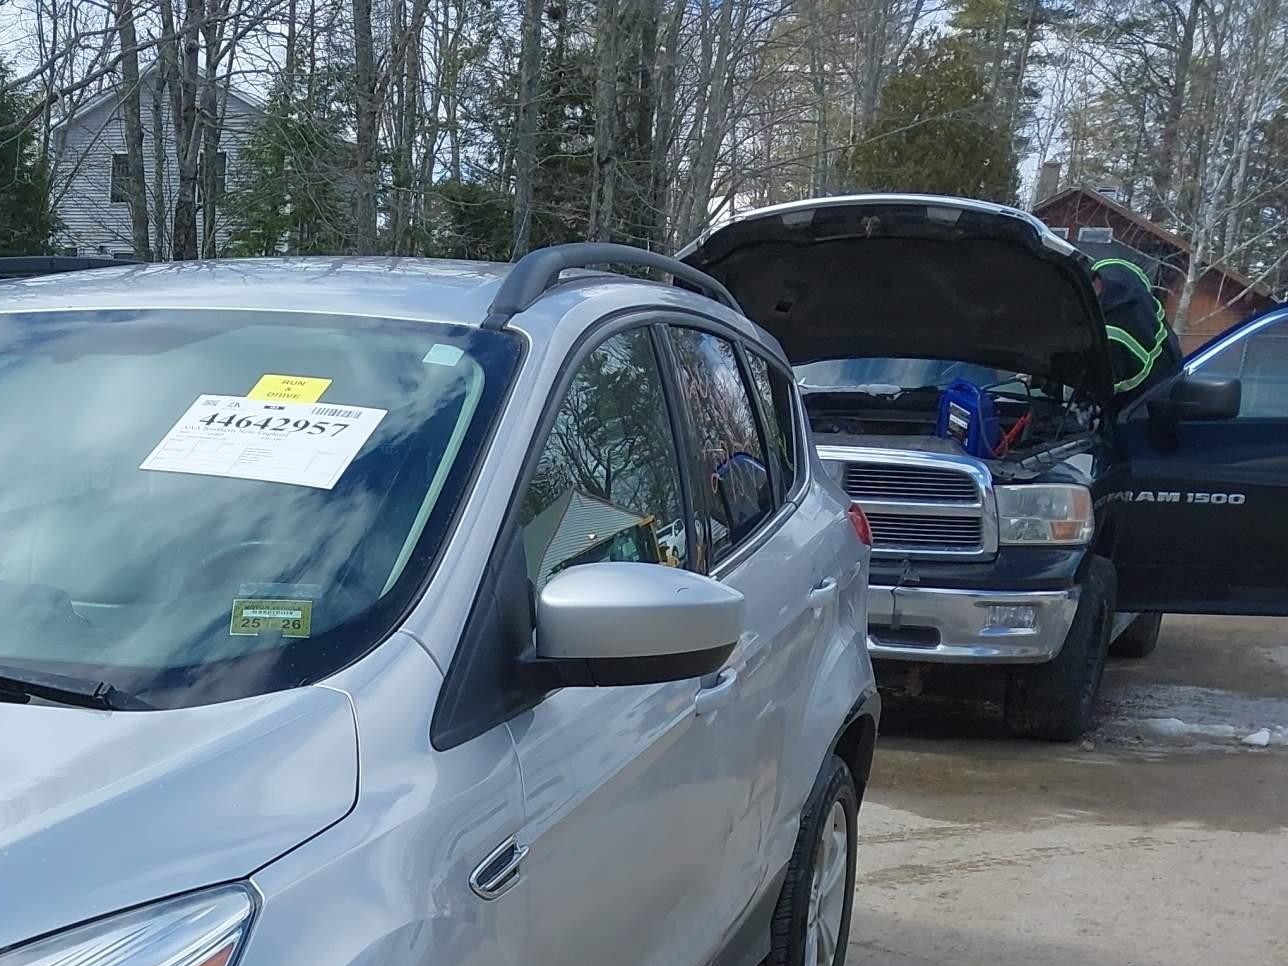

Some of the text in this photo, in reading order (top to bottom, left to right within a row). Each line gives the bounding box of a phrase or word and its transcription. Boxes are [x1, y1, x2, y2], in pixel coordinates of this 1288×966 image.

[281, 378, 306, 387] RUN
[266, 390, 302, 400] DRIVE
[199, 412, 351, 438] 44642957
[1186, 492, 1246, 505] 1500
[241, 618, 301, 630] 25 26
